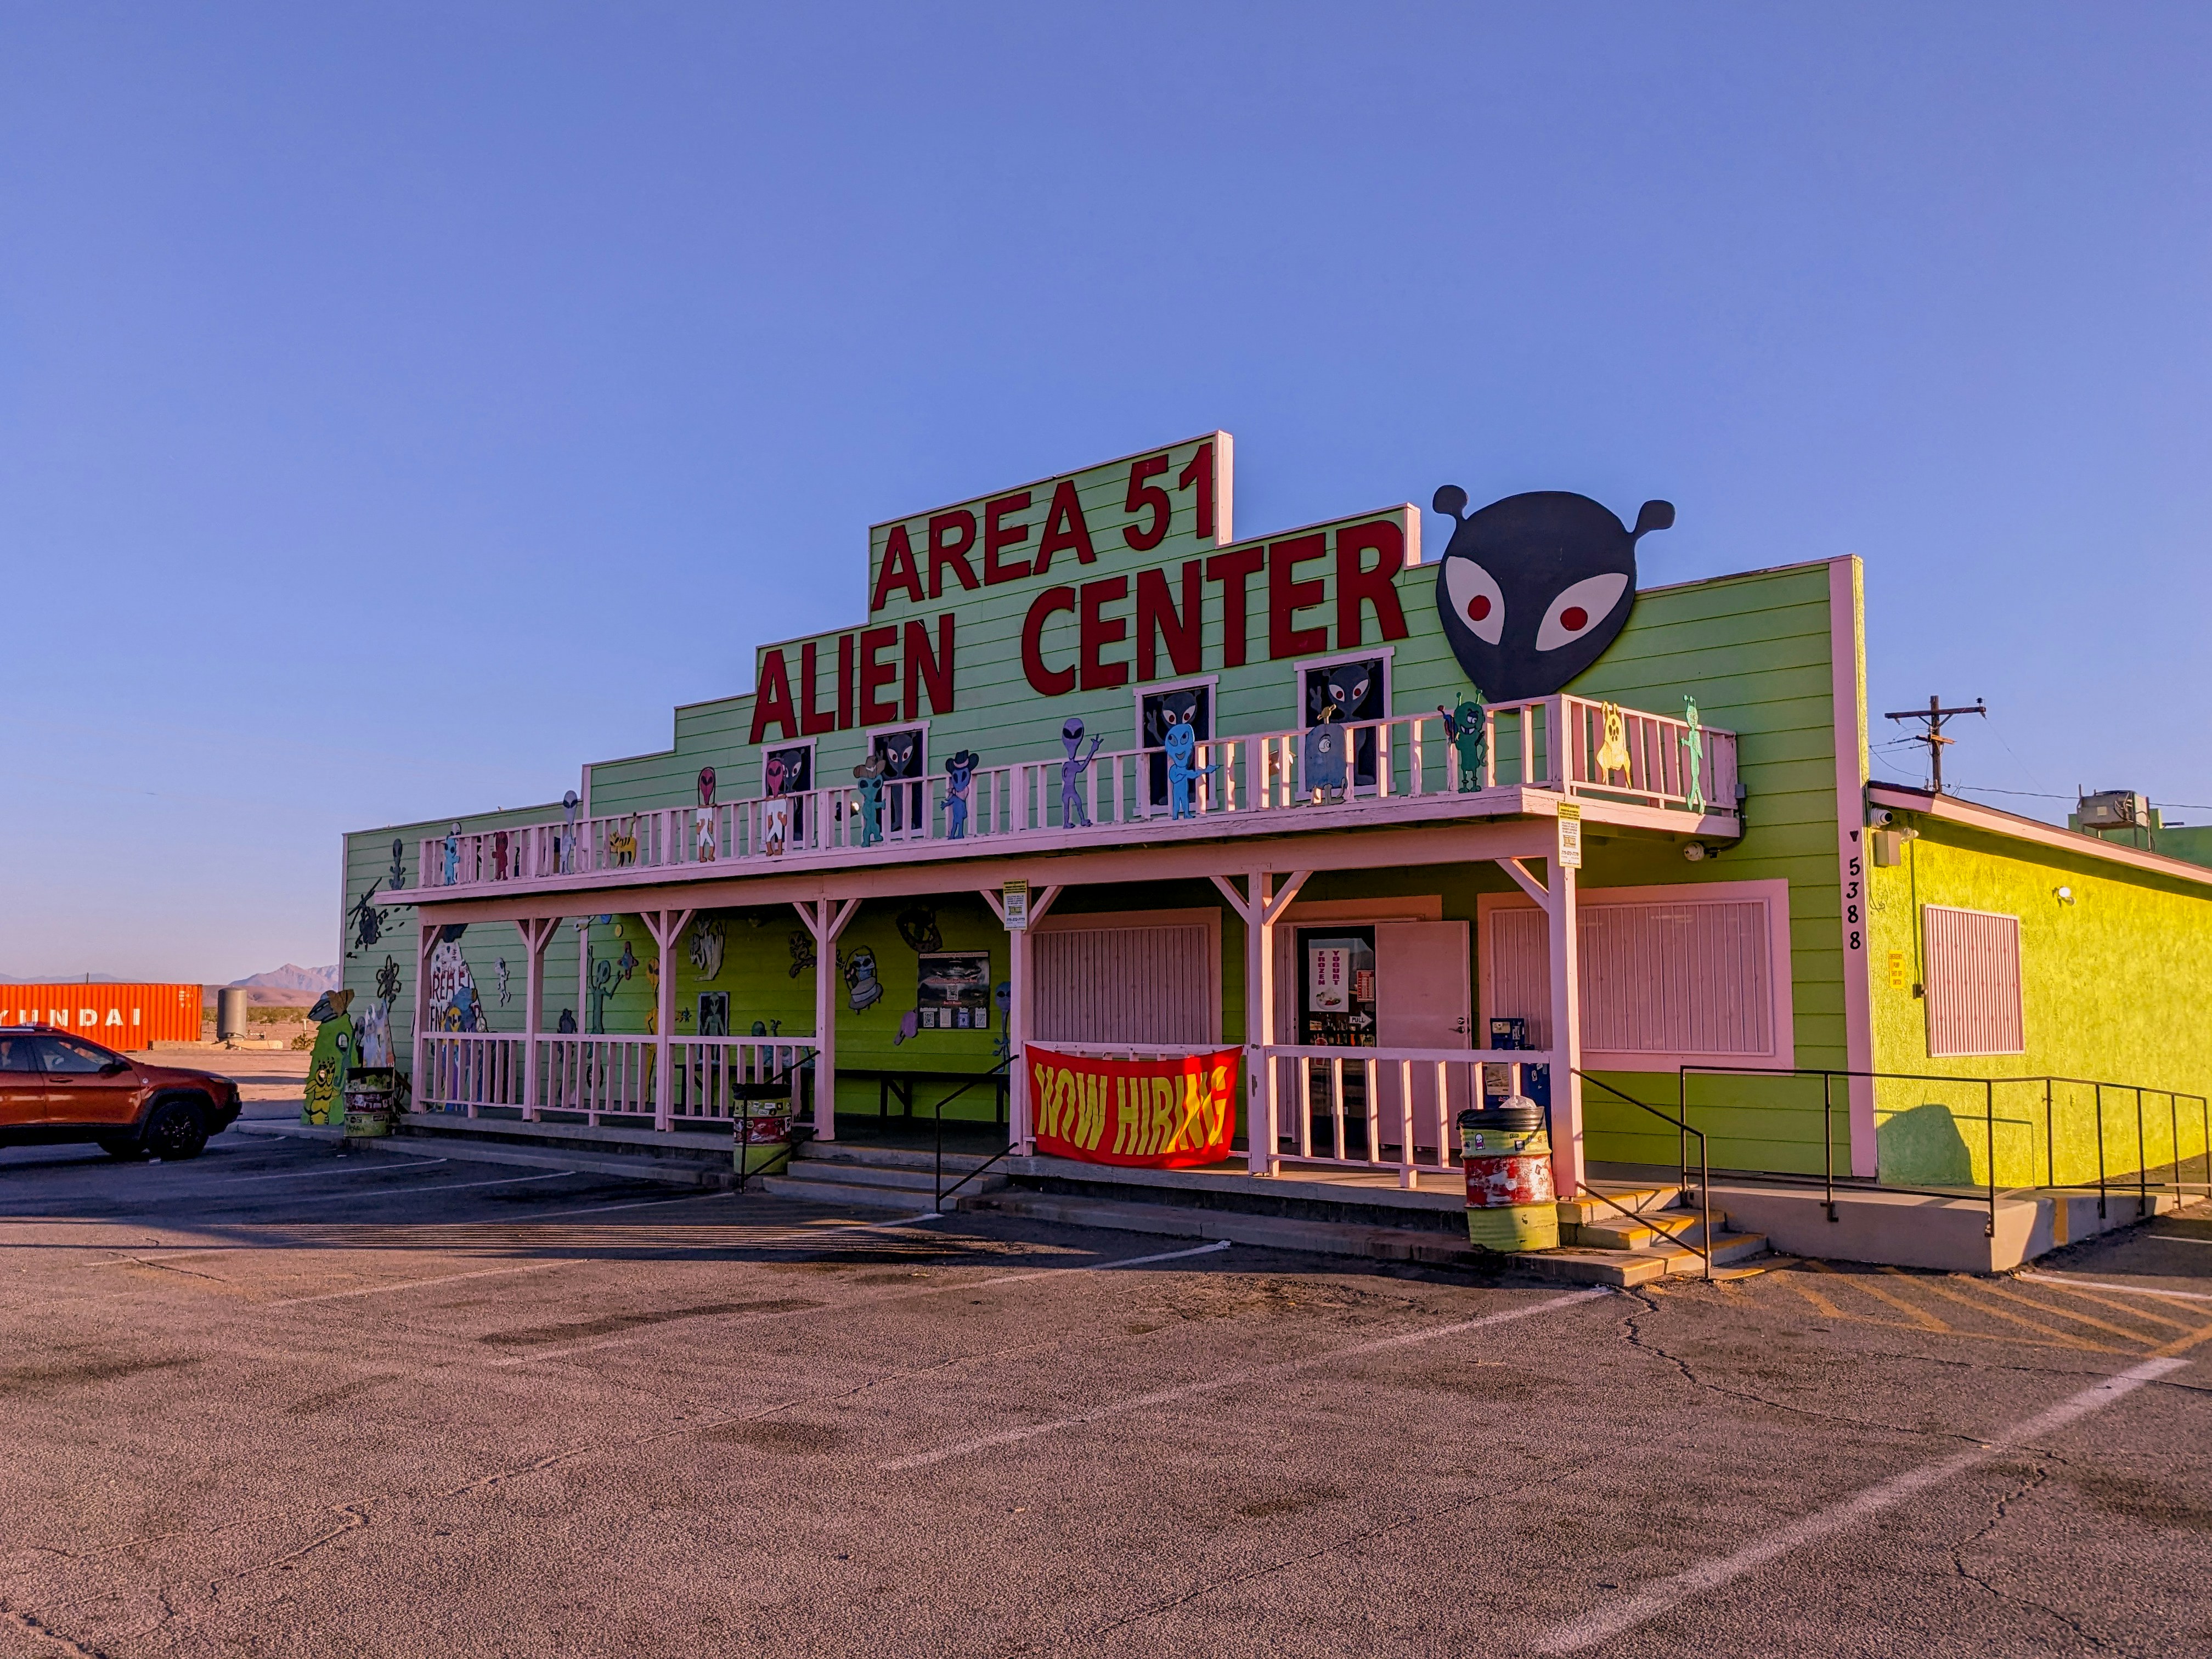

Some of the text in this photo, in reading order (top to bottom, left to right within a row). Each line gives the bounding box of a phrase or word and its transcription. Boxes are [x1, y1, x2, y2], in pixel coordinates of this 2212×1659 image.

[870, 443, 1214, 612] AREA 51
[749, 520, 1409, 744] ALIEN CENTER
[1846, 856, 1861, 950] 5388
[1035, 1063, 1227, 1155] NOW HIRING
